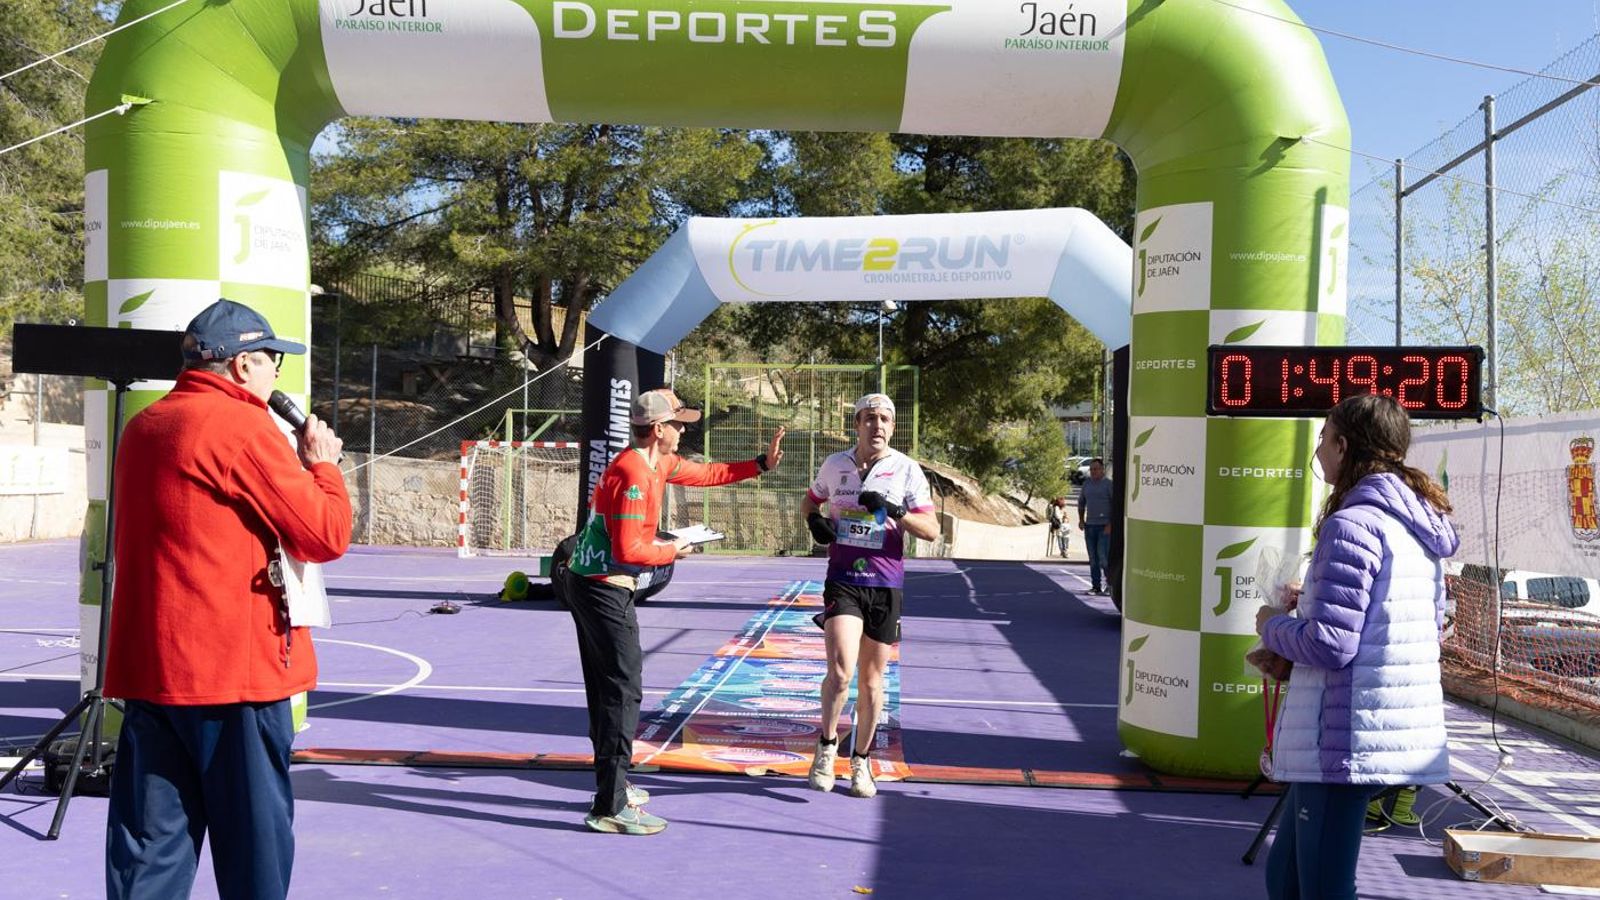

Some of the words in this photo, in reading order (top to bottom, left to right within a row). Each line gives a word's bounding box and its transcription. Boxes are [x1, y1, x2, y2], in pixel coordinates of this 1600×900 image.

[335, 18, 385, 31] PARAÍSO
[387, 21, 443, 33] INTERIOR
[553, 1, 897, 47] DEPORTES
[1020, 2, 1096, 36] Jaén
[1004, 36, 1054, 50] PARAÍSO
[1056, 39, 1109, 52] INTERIOR
[1147, 251, 1201, 266] DIPUTACIÓN
[1229, 251, 1307, 264] www.dipujaen.es
[863, 272, 949, 284] CRONOMETRAJE
[951, 270, 1012, 282] DEPORTIVO
[1147, 269, 1157, 278] DE
[1157, 265, 1180, 277] JAÉN
[1136, 359, 1196, 370] DEPORTES
[604, 378, 632, 449] LÍMITES
[1142, 463, 1195, 475] DIPUTACIÓN
[1219, 467, 1303, 478] DEPORTES
[1142, 477, 1150, 485] DE
[1150, 475, 1173, 487] JAÉN
[850, 524, 871, 535] 537
[1235, 589, 1251, 599] DE
[1136, 669, 1189, 688] DIPUTACIÓN
[1135, 682, 1145, 693] DE
[1146, 685, 1168, 698] JAÉN
